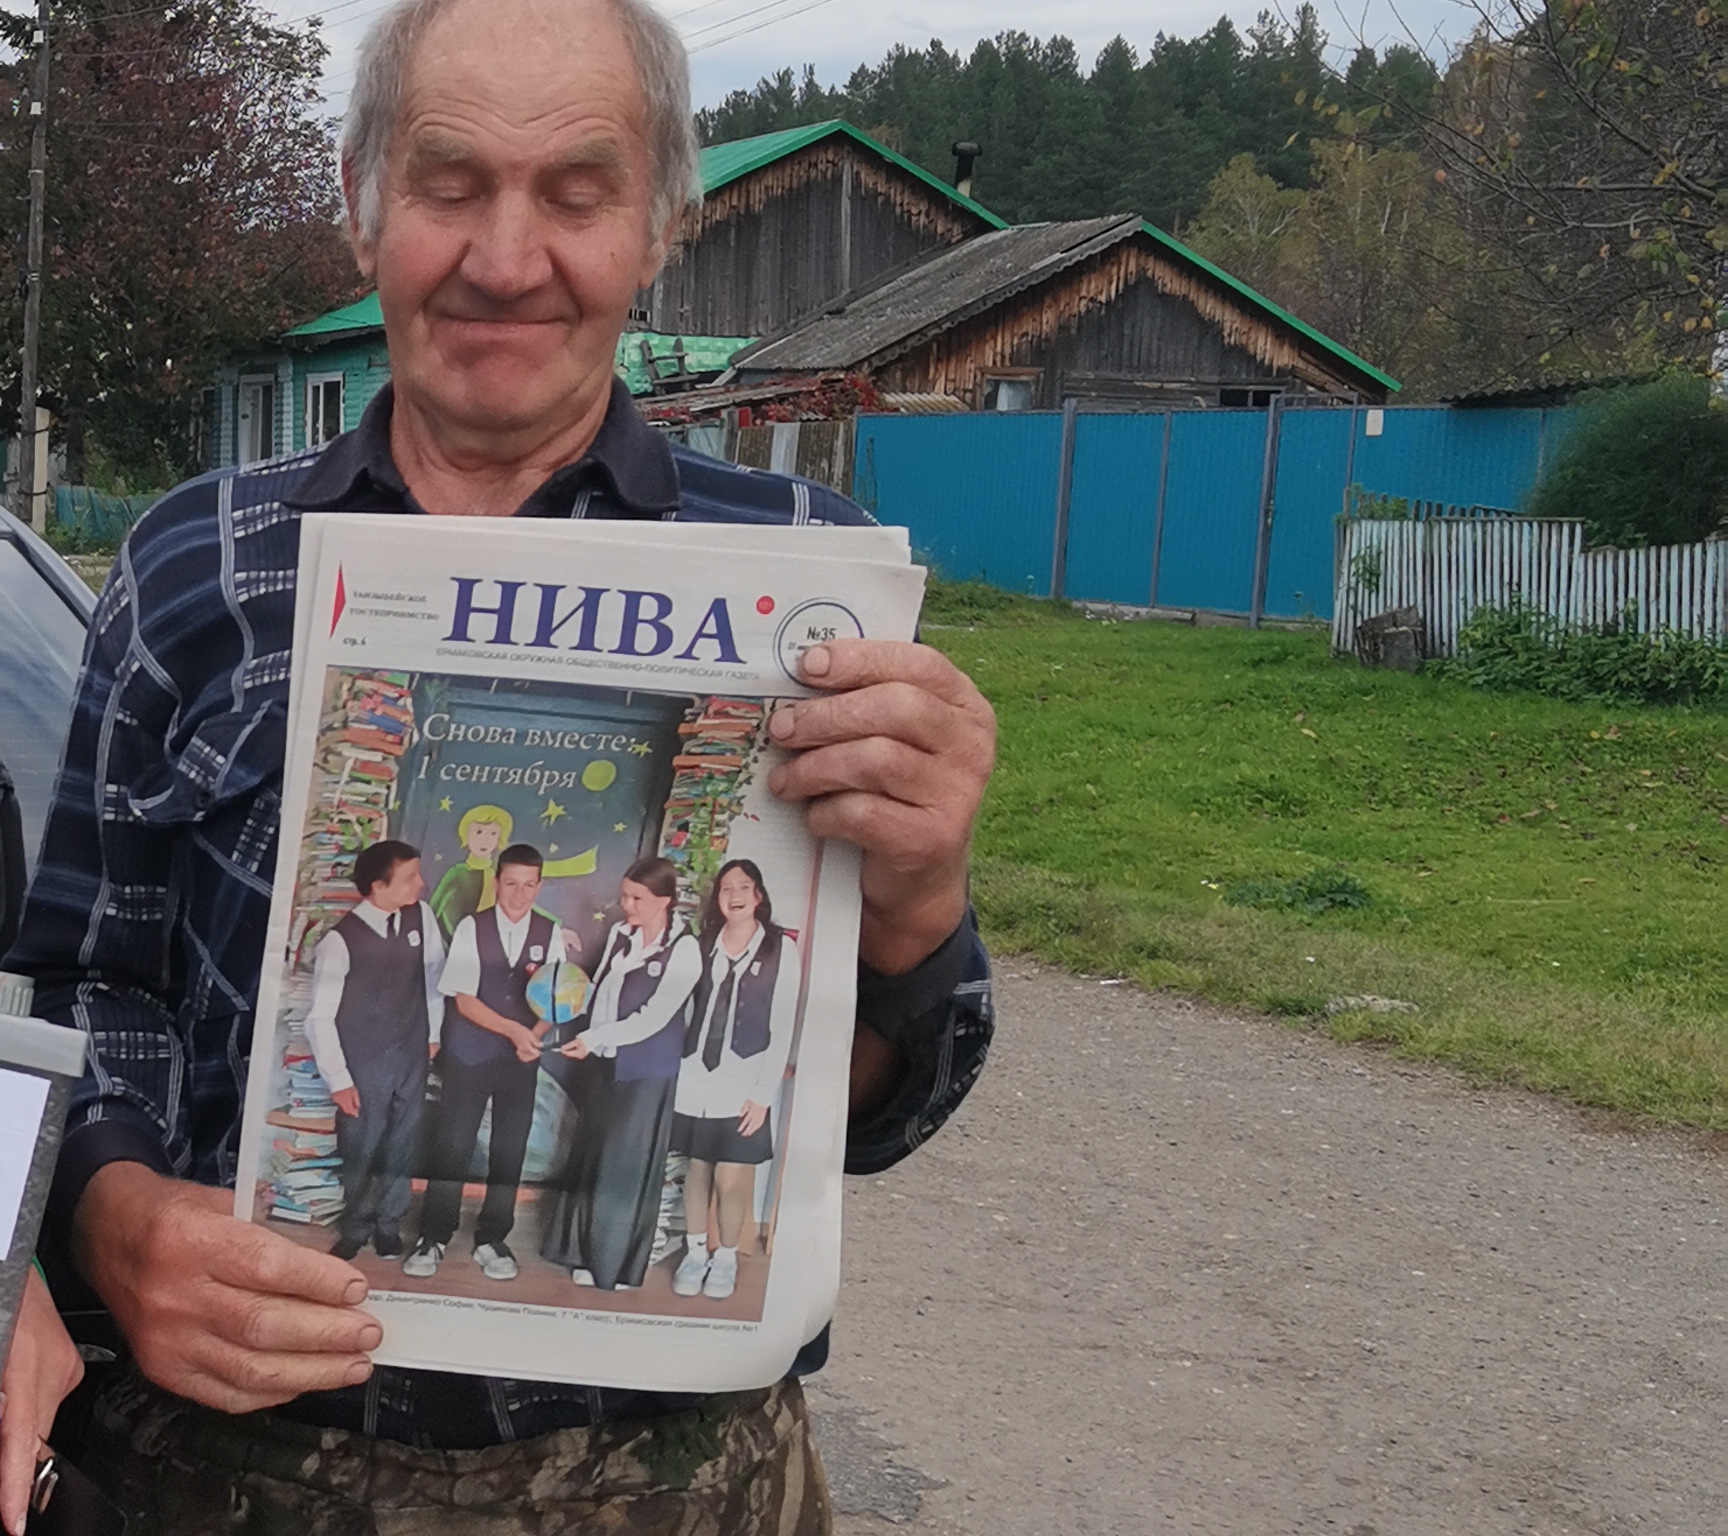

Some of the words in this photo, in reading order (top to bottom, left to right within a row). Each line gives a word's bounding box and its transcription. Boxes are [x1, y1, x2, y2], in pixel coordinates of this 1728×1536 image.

[440, 576, 749, 665] НИВА
[435, 647, 508, 661] ЕРМАКОВСКАЯ
[509, 652, 564, 665] ОКРУЖНАЯ
[724, 669, 761, 681] ГАЗЕТА
[422, 712, 516, 746] Снова
[417, 754, 430, 780] 1
[439, 759, 578, 796] сентября
